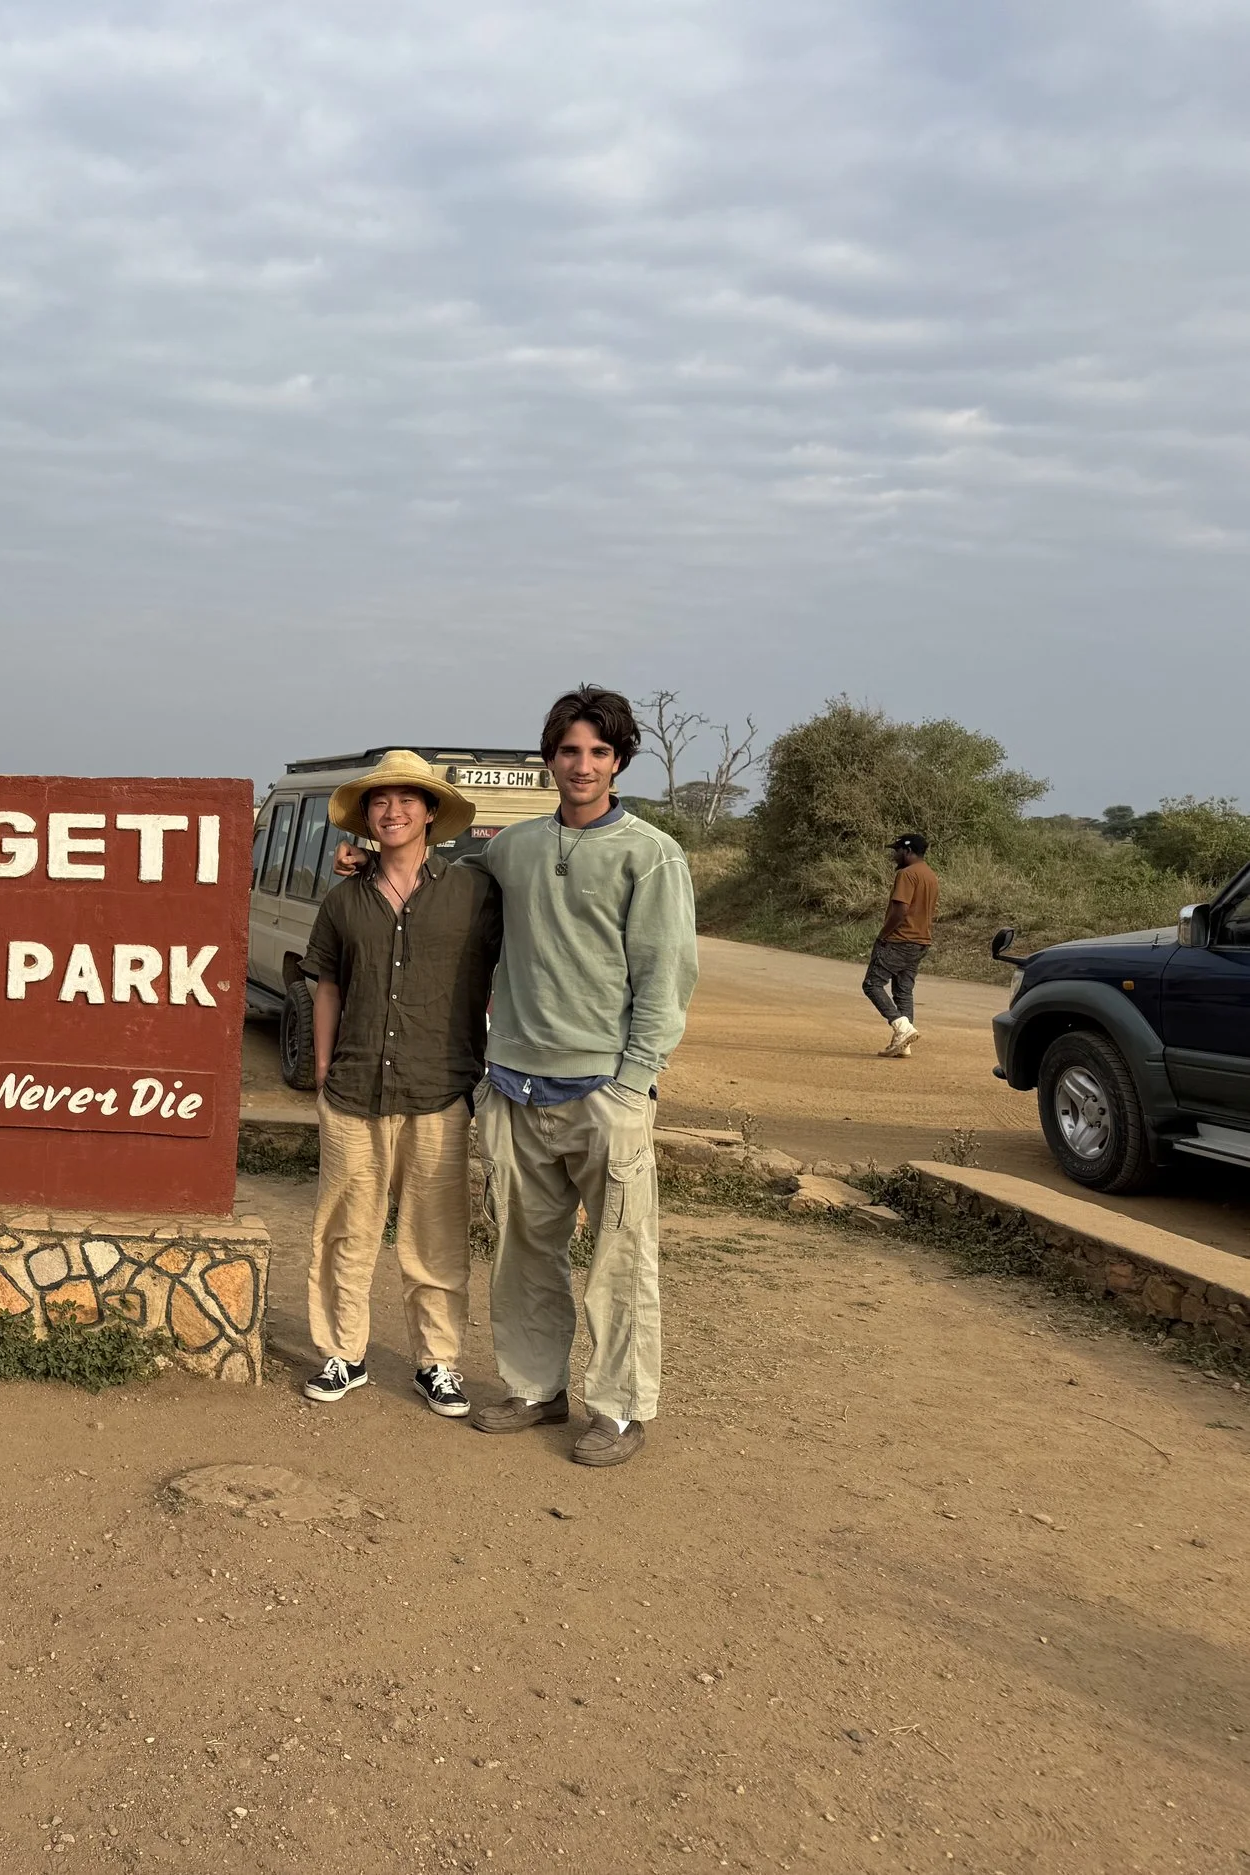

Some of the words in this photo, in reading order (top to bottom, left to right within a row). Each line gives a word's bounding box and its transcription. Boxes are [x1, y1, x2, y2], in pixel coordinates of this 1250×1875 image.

[466, 770, 501, 785] T213
[507, 772, 534, 786] CHM
[6, 940, 220, 1008] PARK
[128, 1077, 203, 1120] Die
